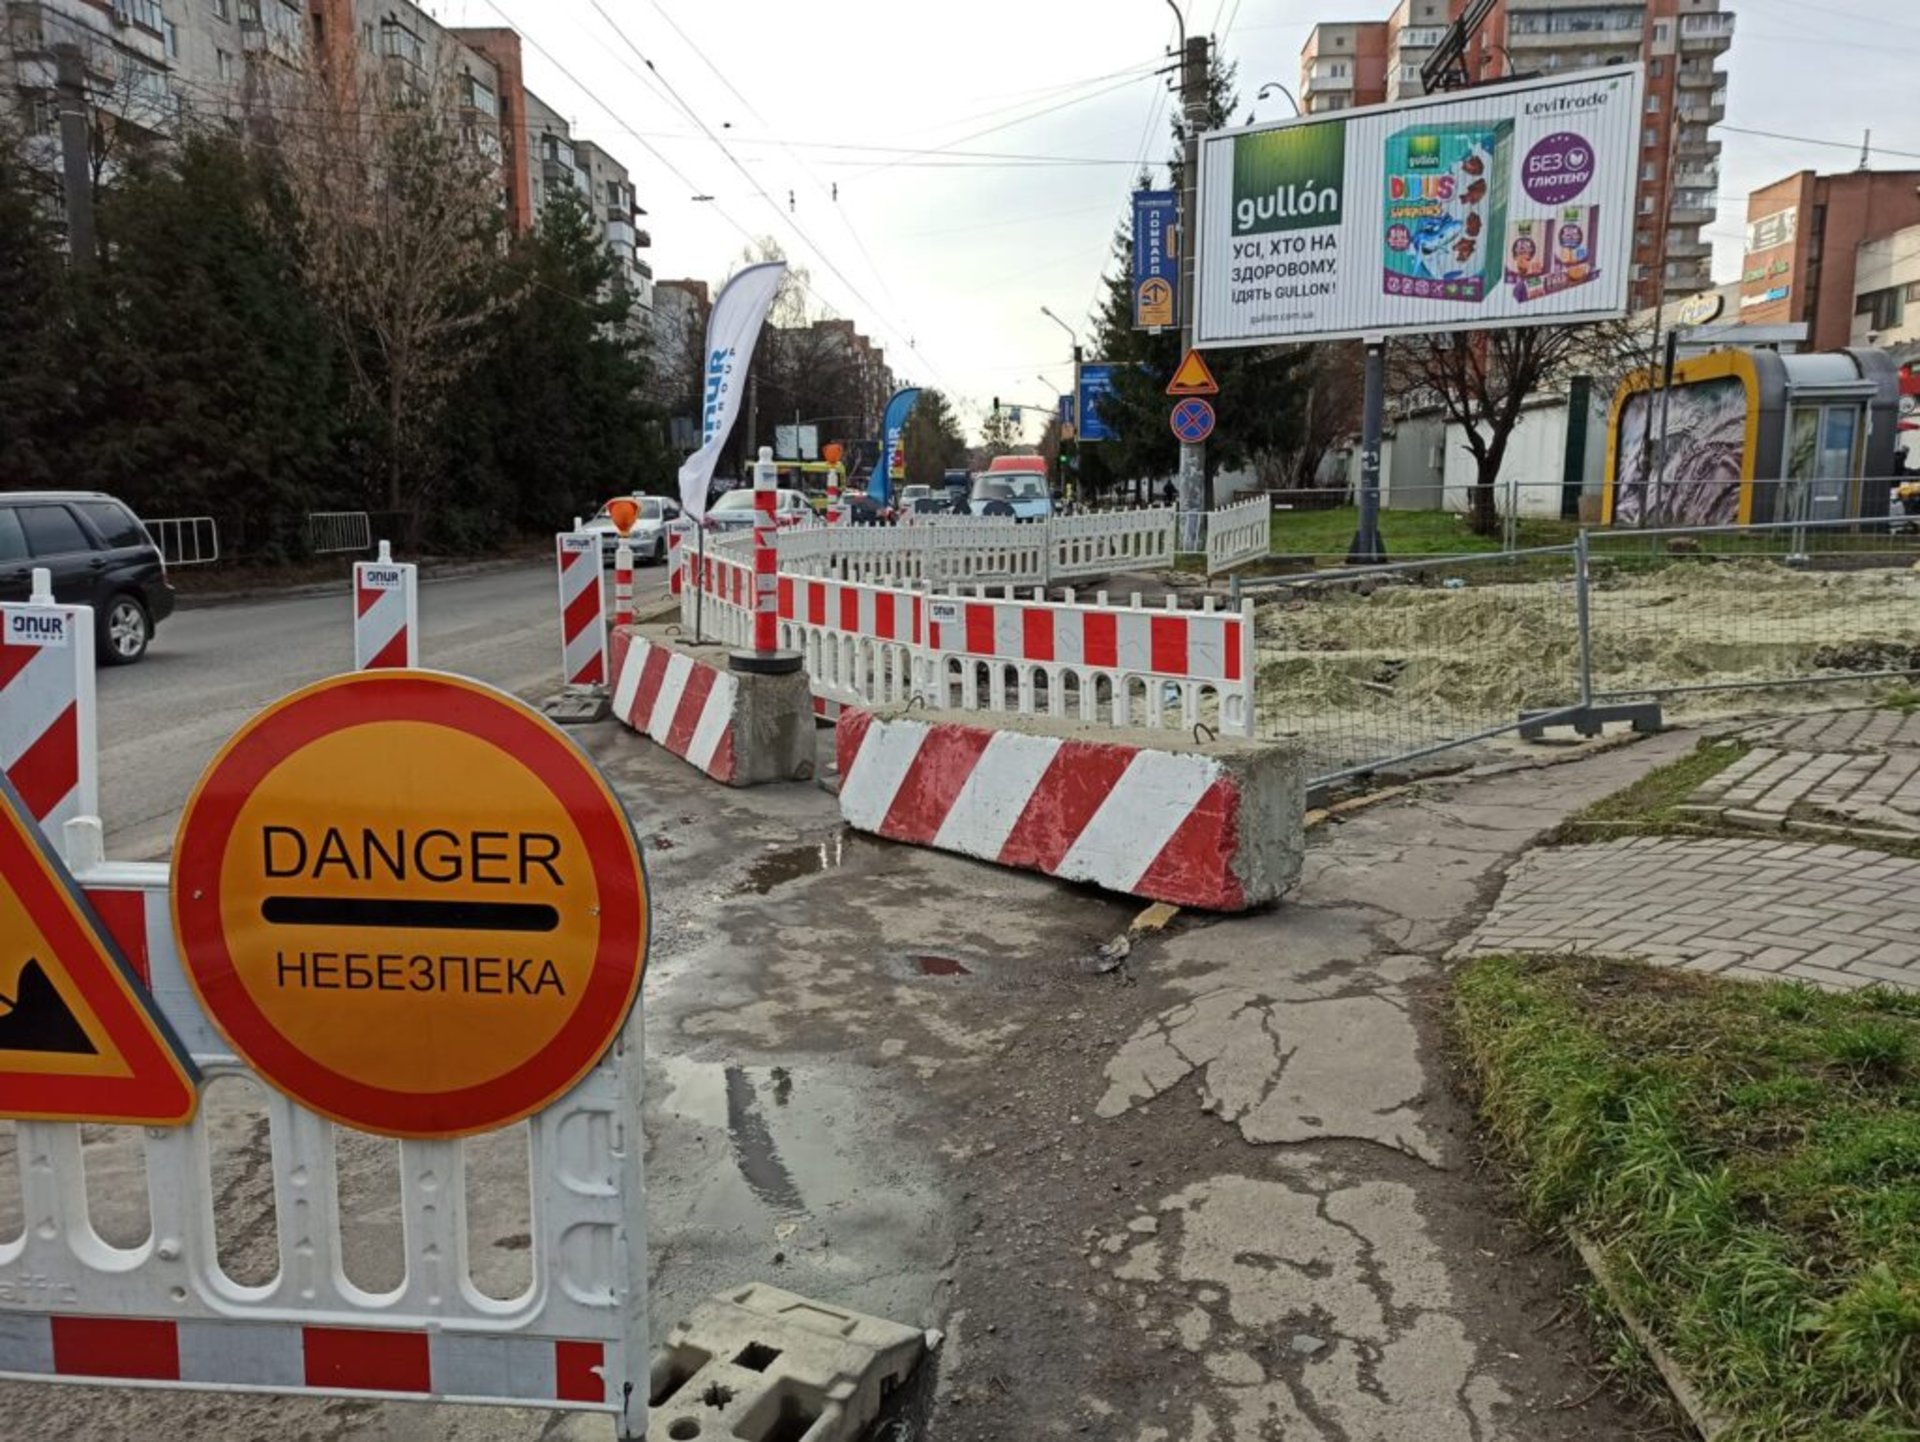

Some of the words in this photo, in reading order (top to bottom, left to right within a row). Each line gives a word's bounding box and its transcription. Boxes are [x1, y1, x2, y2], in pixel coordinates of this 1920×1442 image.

[1525, 93, 1608, 115] LeviTrade
[1529, 153, 1562, 173] БЕЗ
[1527, 171, 1590, 189] ГЛЮТЕНУ
[1237, 179, 1338, 230] gullón
[1233, 241, 1265, 260] УСІ,
[1270, 237, 1306, 256] ХТО
[1311, 233, 1336, 251] НА
[1231, 258, 1337, 284] ЗДОРОВОМУ,
[367, 571, 399, 582] ONUR
[13, 616, 63, 633] ONUR
[262, 826, 566, 886] DANGER
[276, 951, 566, 996] НЕБЕЗПЕКА
